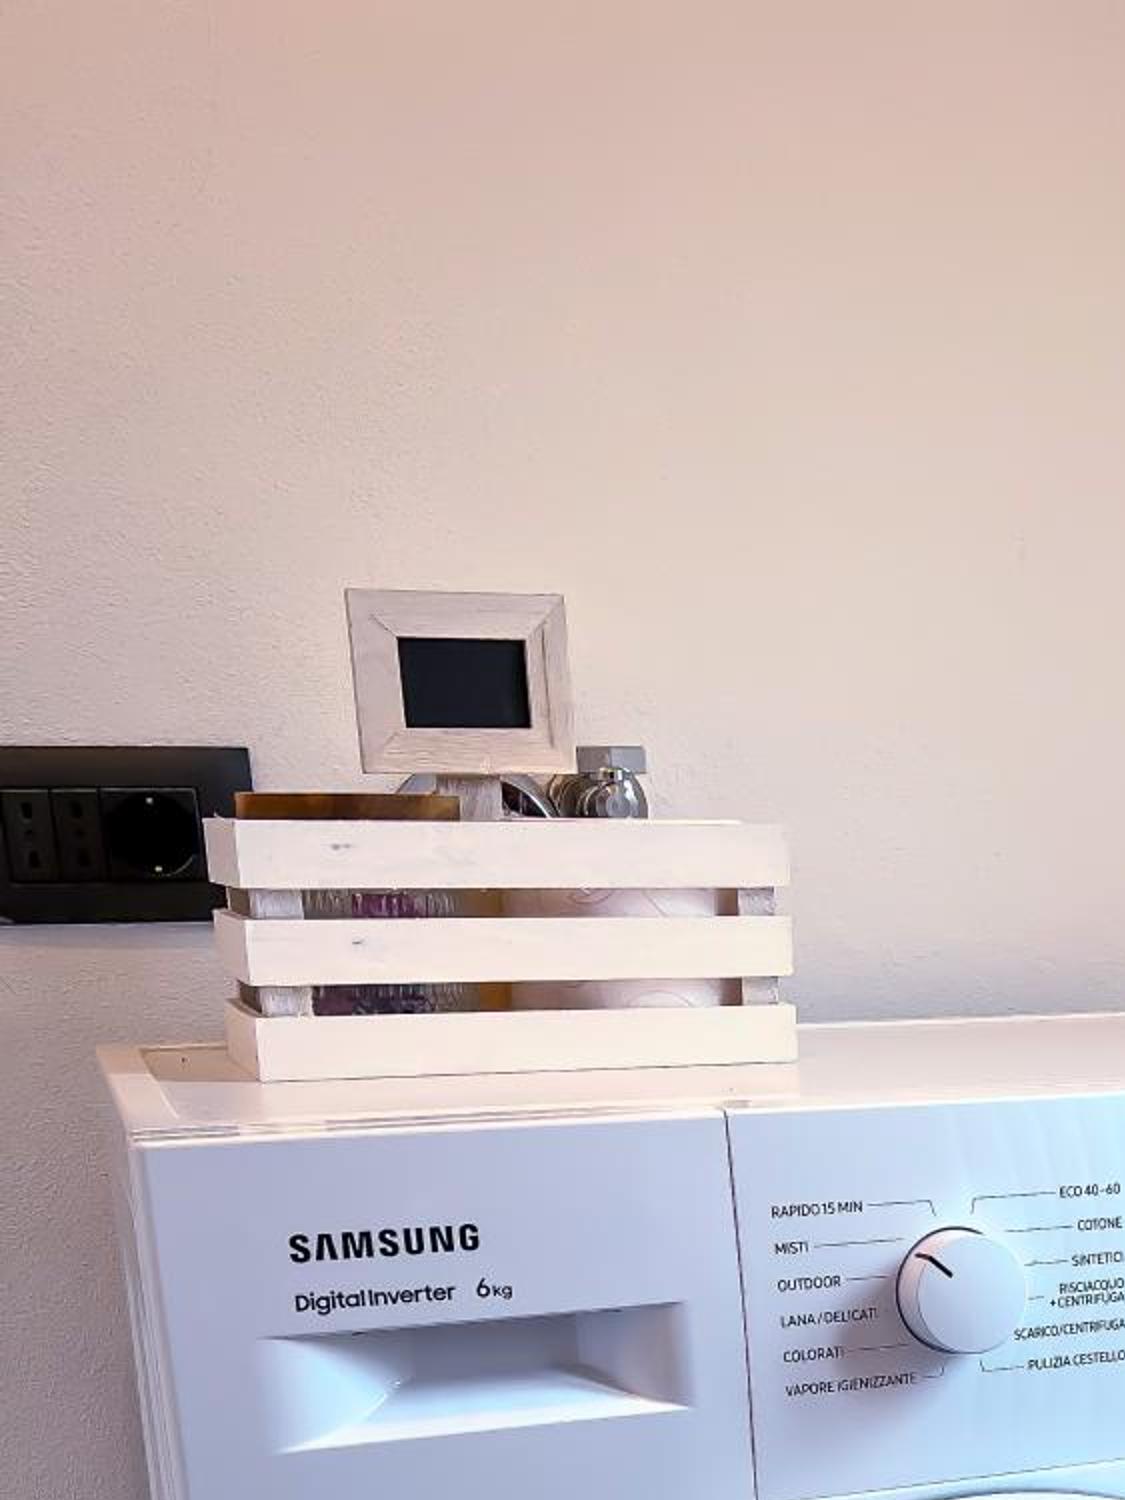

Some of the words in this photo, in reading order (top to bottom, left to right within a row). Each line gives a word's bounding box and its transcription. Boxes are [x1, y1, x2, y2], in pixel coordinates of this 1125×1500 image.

[1059, 1185, 1082, 1198] ECO
[771, 1202, 819, 1218] RAPIDO
[822, 1201, 835, 1215] 15
[837, 1200, 863, 1213] MIN
[1077, 1216, 1123, 1231] COTONE
[288, 1223, 480, 1263] SAMSUNG
[775, 1241, 809, 1255] MISTI
[1071, 1251, 1124, 1267] SINTETICI
[777, 1275, 841, 1293] OUTDOOR
[1059, 1277, 1125, 1294] RISCIACQUO
[783, 1345, 845, 1363] COLORATI
[1027, 1355, 1071, 1370] PULIZIA
[785, 1381, 835, 1397] VAPORE
[837, 1371, 918, 1392] IGIENIZZANTE
